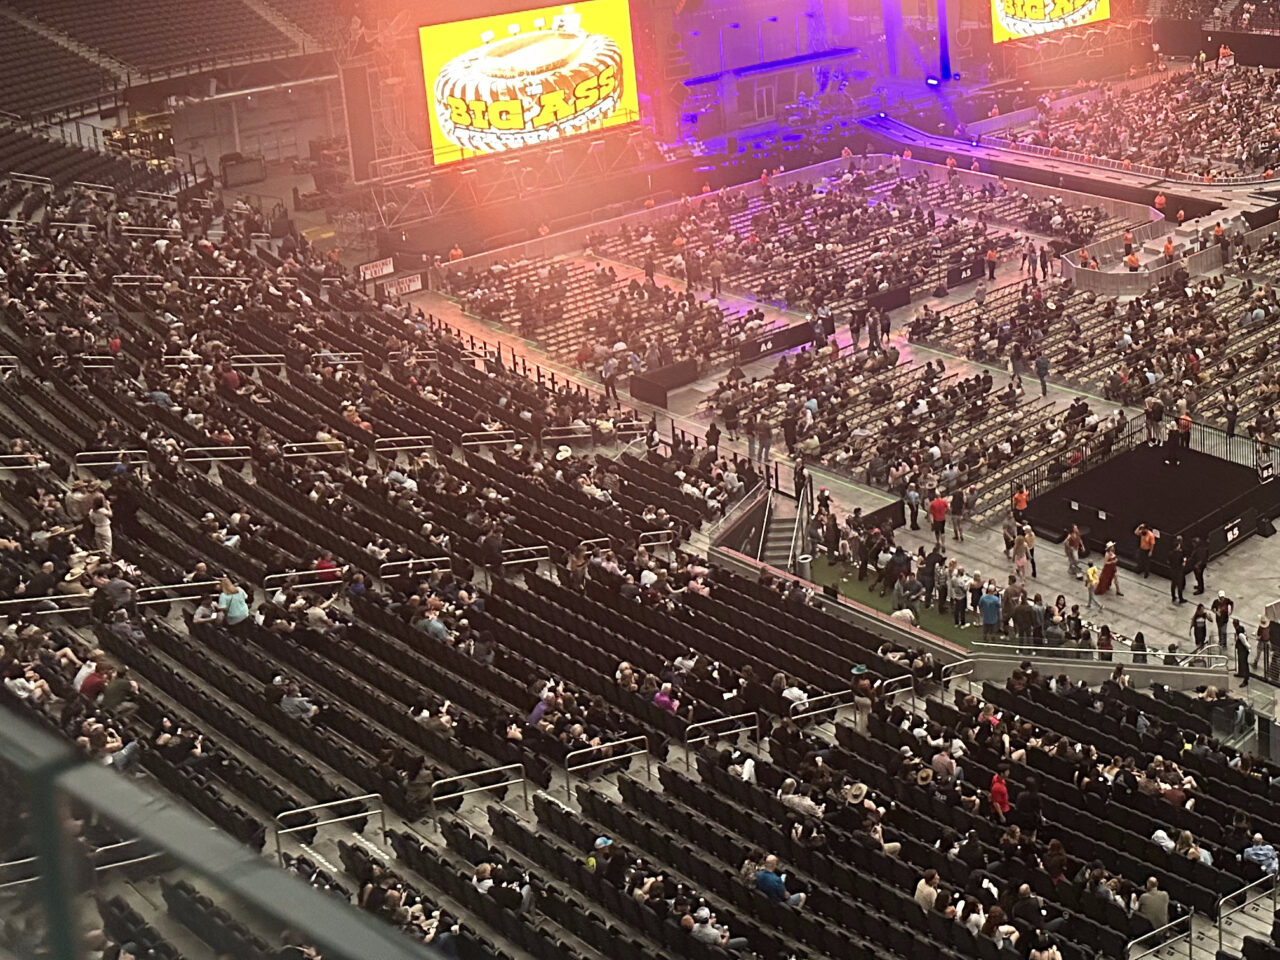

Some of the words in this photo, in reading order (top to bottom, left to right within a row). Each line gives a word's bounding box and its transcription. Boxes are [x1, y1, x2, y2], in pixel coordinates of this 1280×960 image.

[447, 95, 526, 131] BIG
[533, 64, 615, 129] ASS
[1226, 526, 1240, 542] B5
